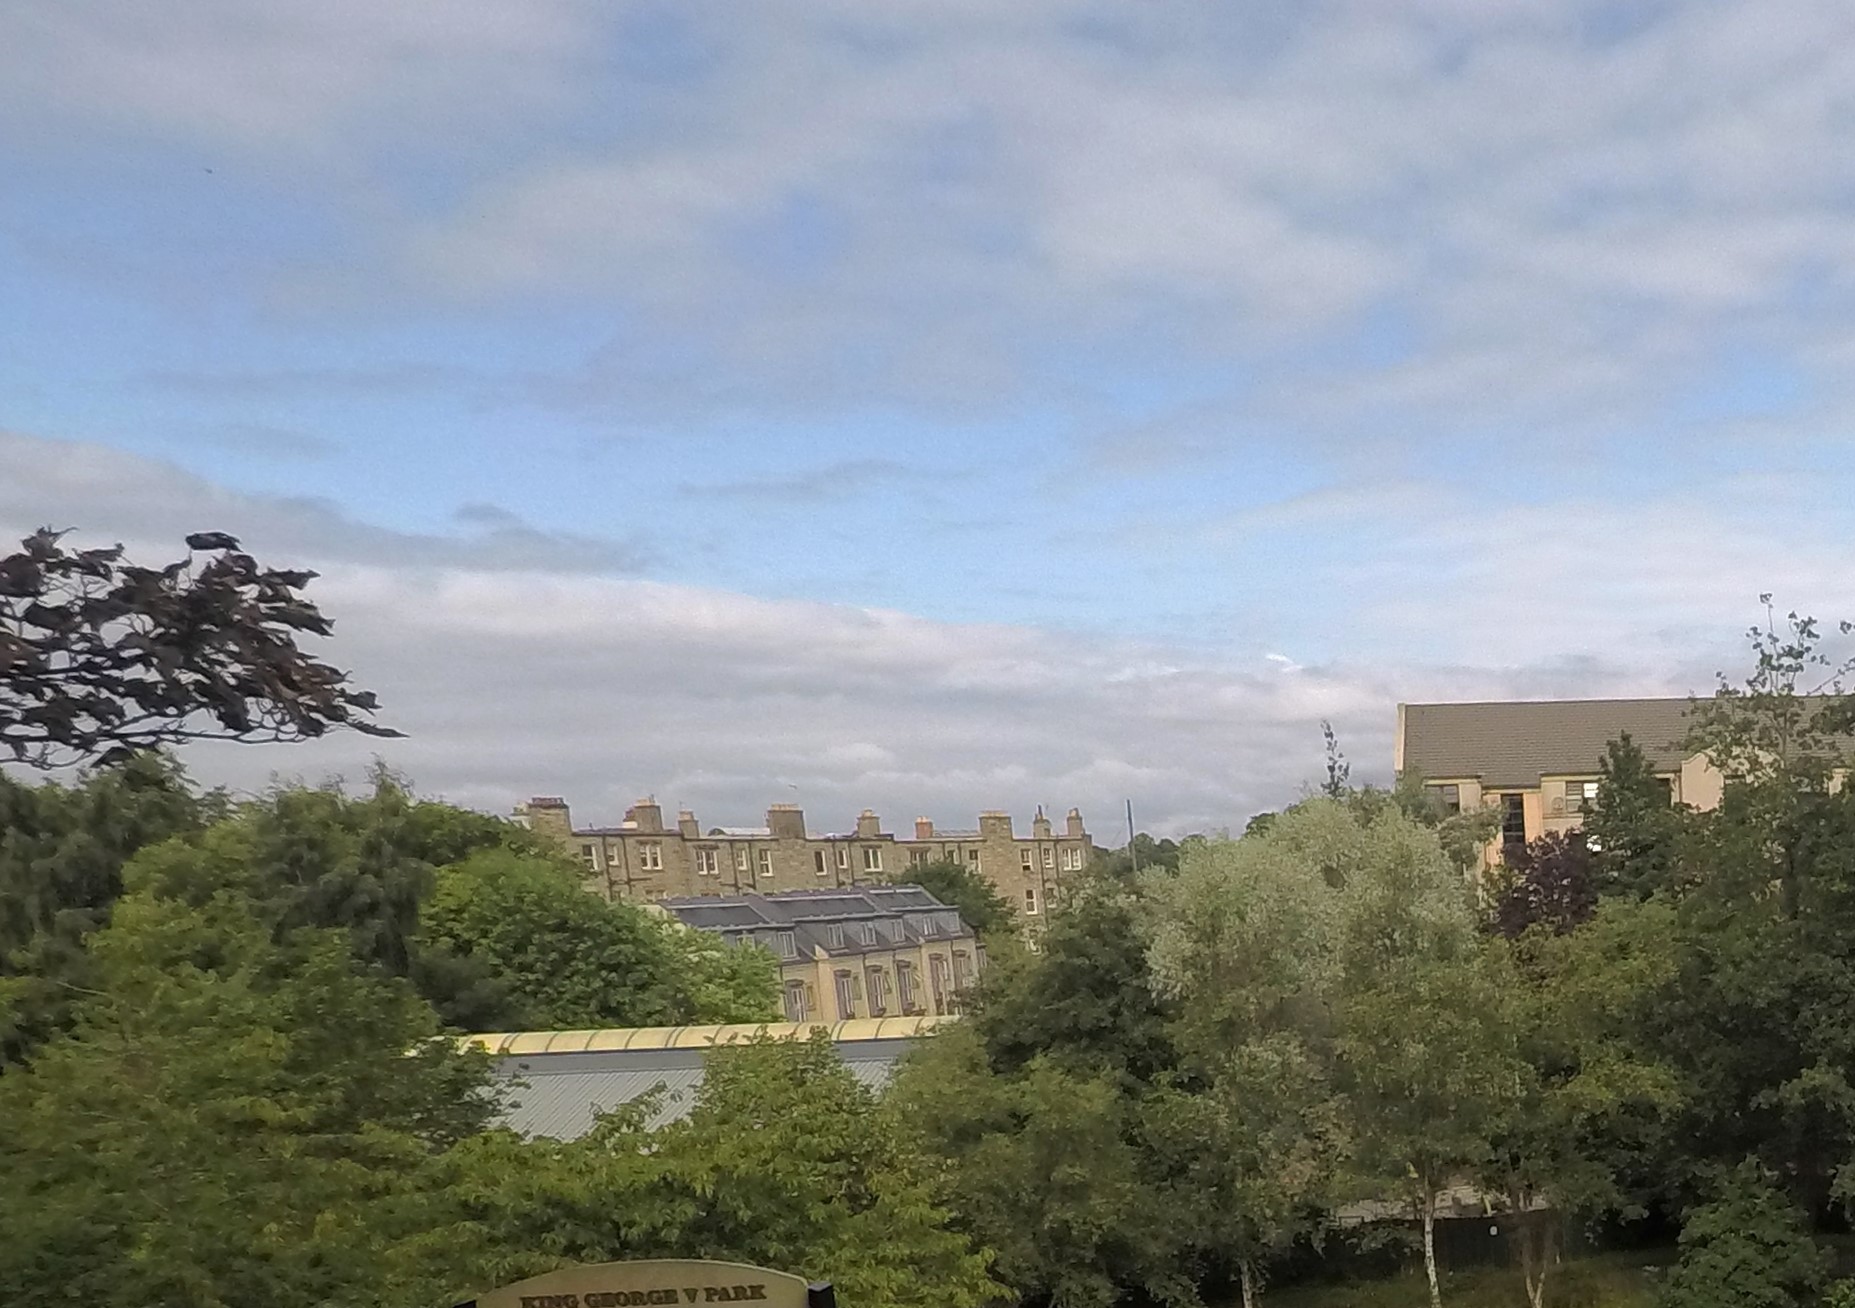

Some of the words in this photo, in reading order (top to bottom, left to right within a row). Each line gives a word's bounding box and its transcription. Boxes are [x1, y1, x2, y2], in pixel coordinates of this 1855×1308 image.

[584, 1288, 679, 1308] GEORGE
[683, 1288, 699, 1304] V
[704, 1285, 767, 1302] PARK
